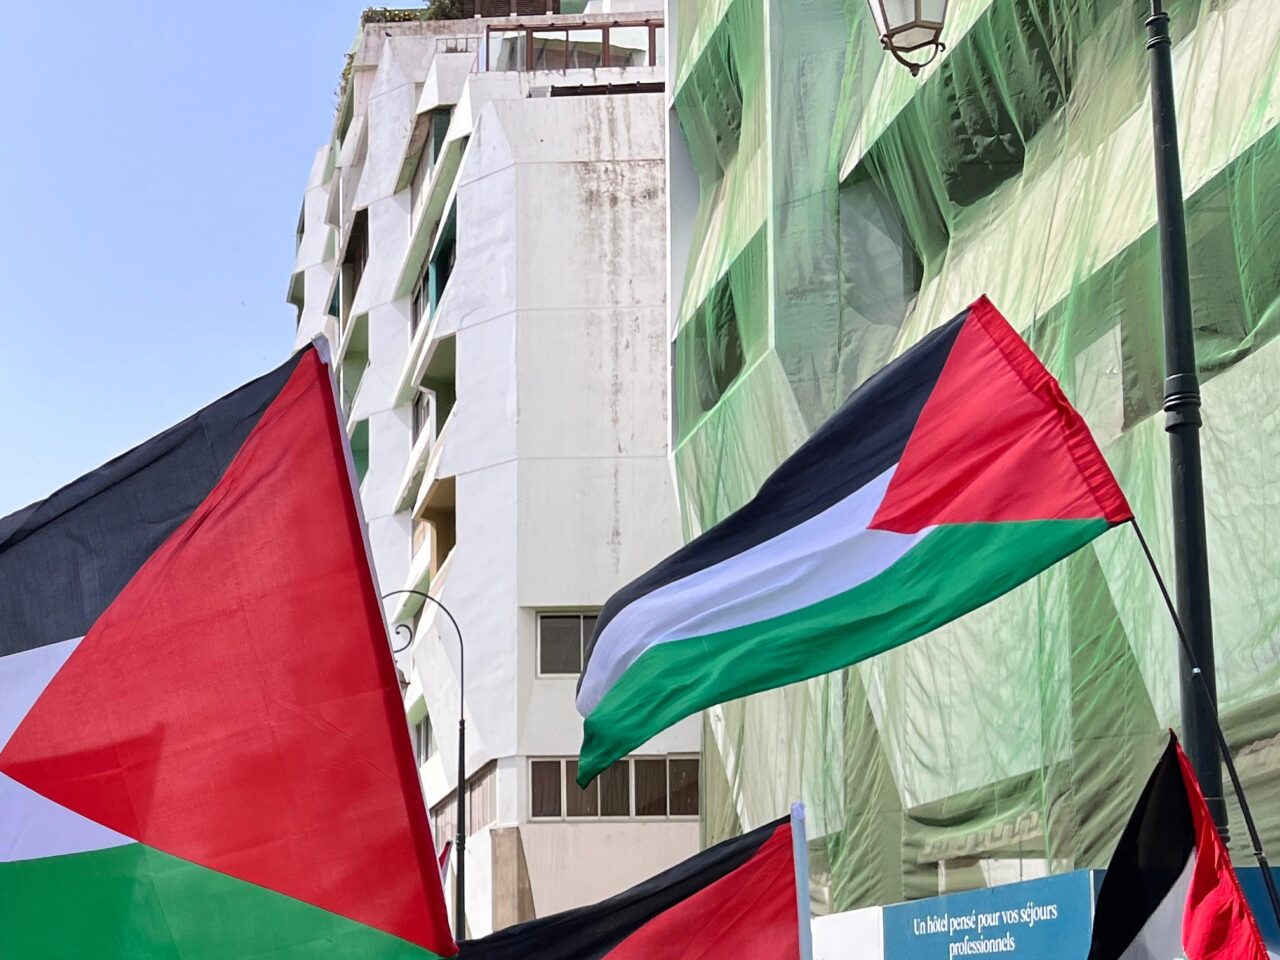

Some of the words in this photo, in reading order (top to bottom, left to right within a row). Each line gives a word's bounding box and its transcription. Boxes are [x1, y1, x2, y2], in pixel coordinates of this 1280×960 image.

[913, 918, 926, 935] Un
[927, 913, 948, 934] hôtel
[949, 908, 976, 936] pensé
[977, 912, 1000, 933] pour
[1001, 909, 1019, 924] vos
[1020, 901, 1058, 927] séjours
[949, 931, 1015, 960] professionnels
